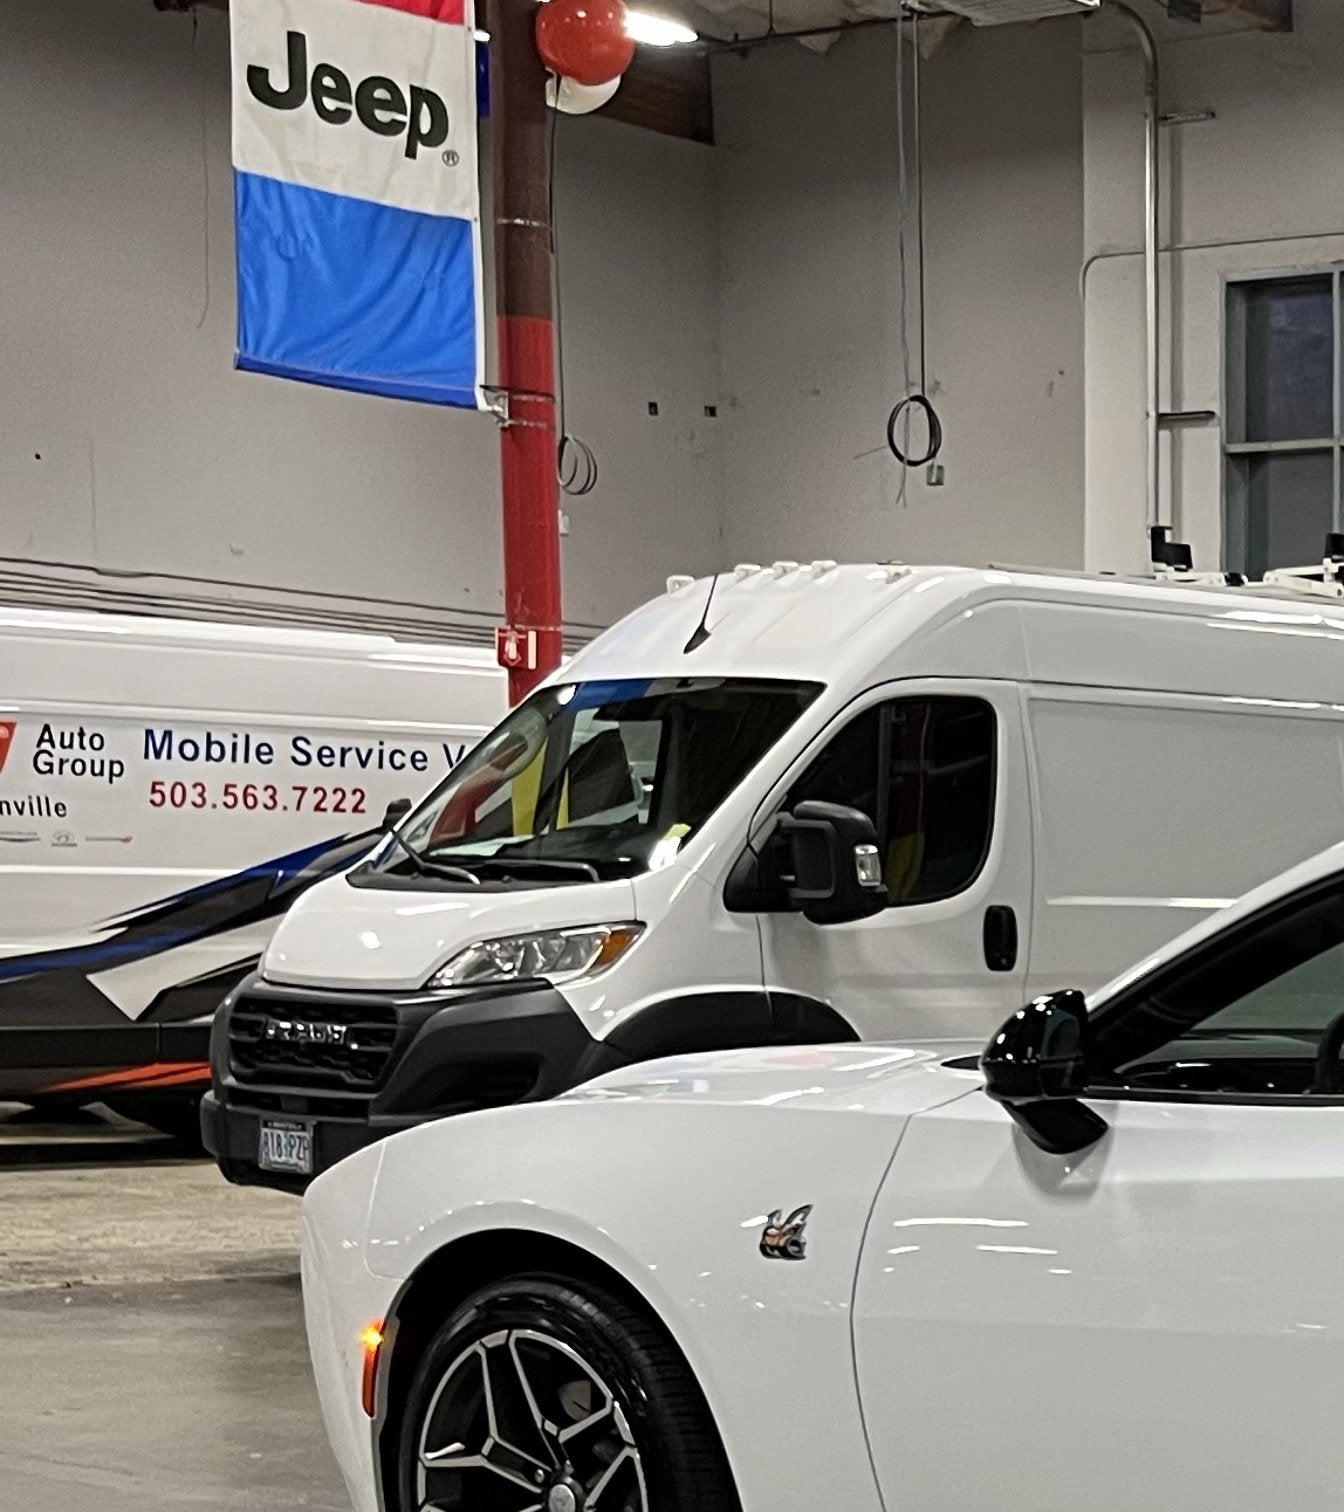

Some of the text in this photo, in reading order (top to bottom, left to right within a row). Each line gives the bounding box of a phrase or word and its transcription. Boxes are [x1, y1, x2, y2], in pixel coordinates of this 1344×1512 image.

[36, 723, 105, 751] Auto
[143, 728, 274, 765] Mobile
[291, 736, 428, 772] Service
[33, 749, 125, 784] Group
[0, 795, 67, 817] nville
[149, 781, 366, 814] 503.563.7222
